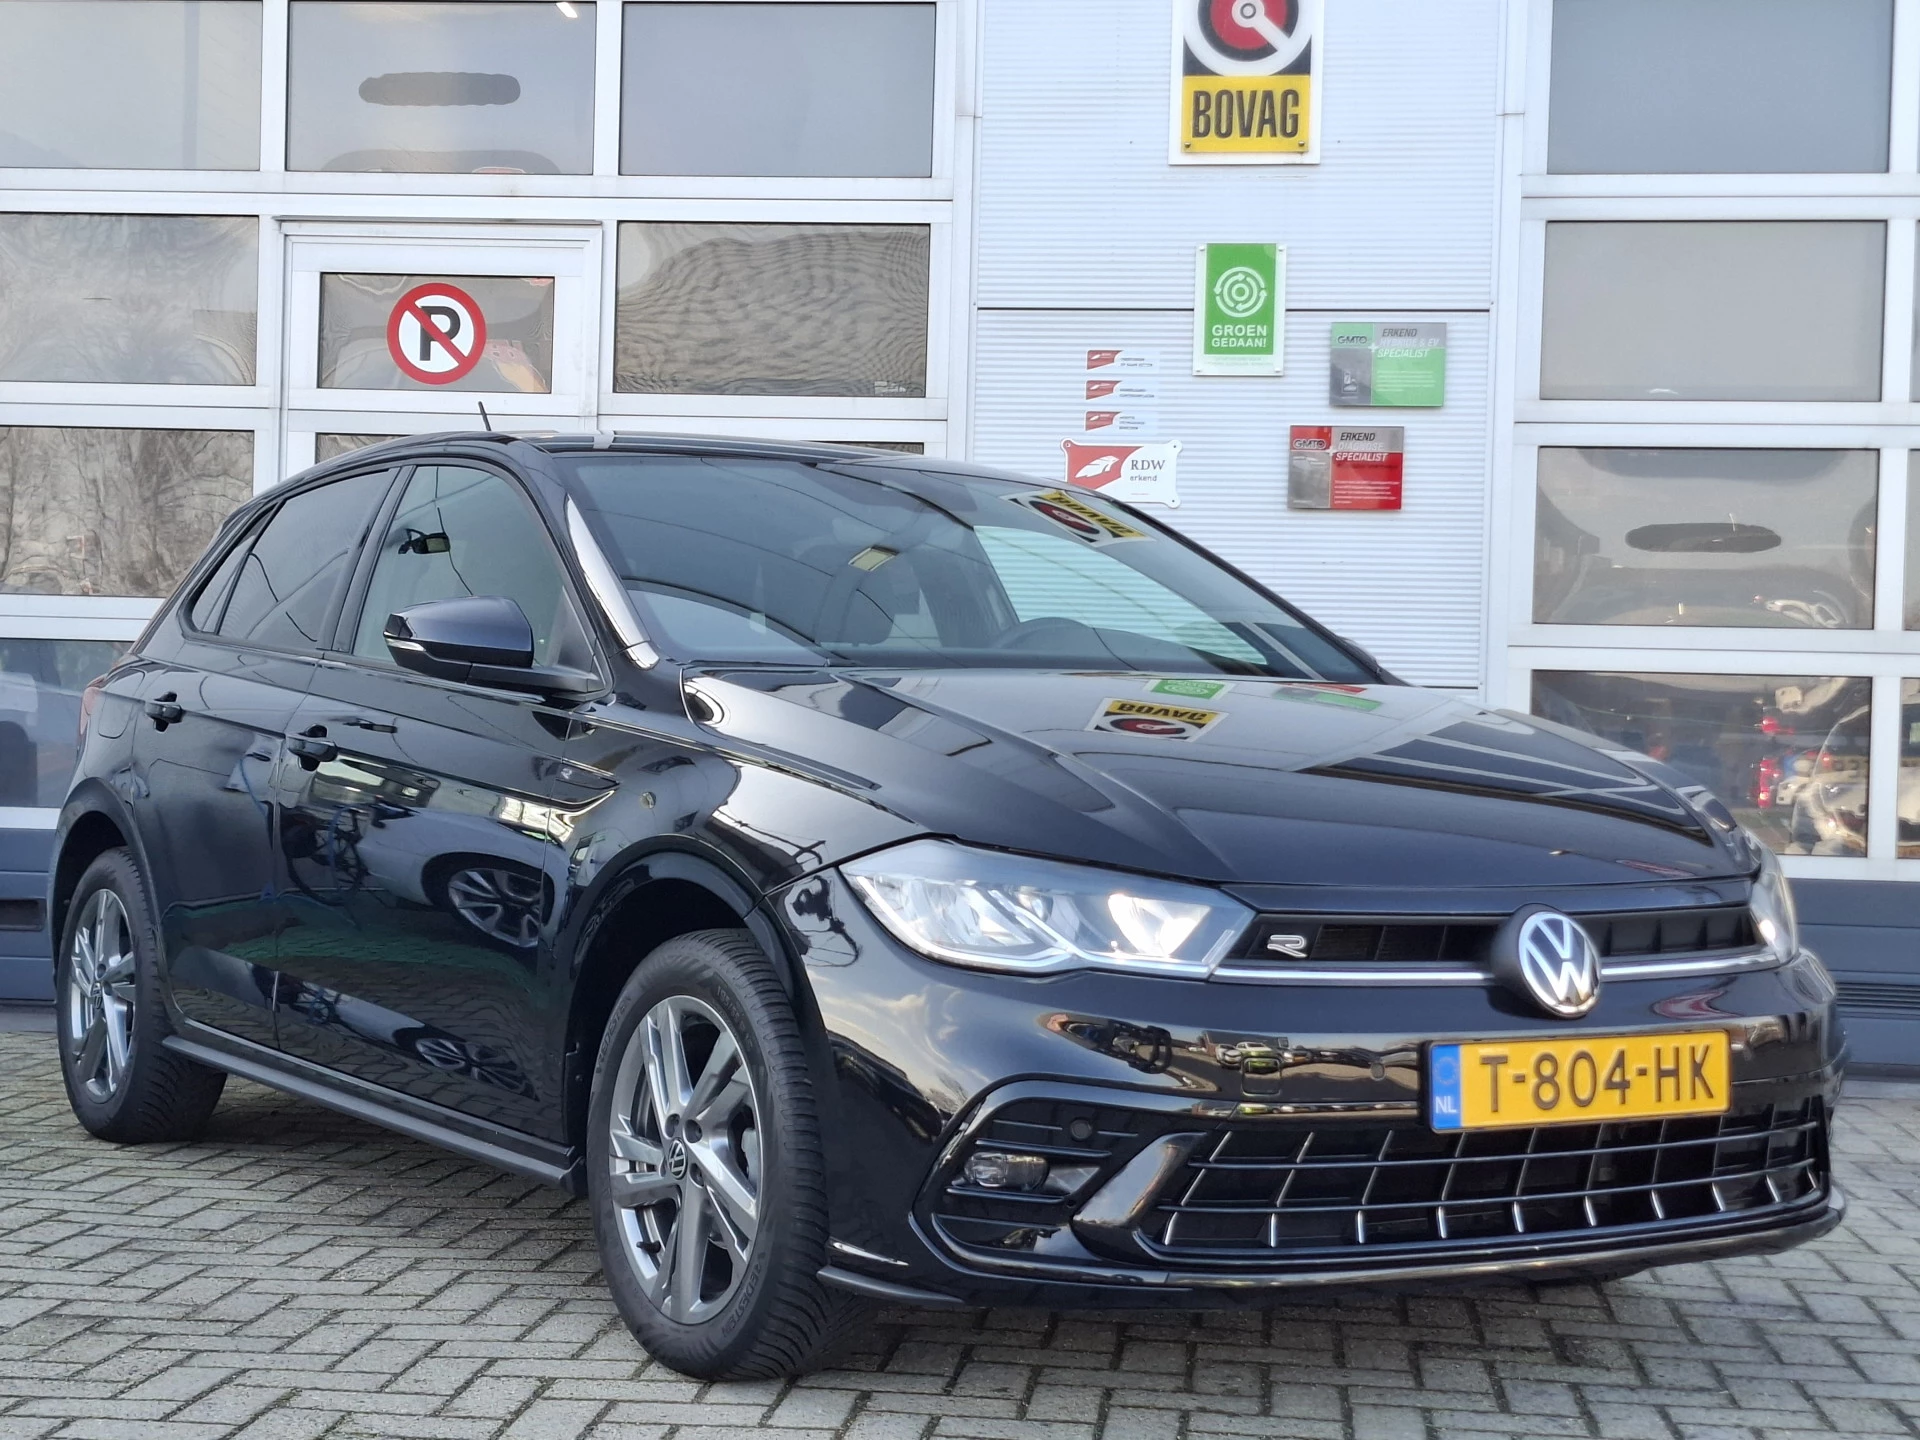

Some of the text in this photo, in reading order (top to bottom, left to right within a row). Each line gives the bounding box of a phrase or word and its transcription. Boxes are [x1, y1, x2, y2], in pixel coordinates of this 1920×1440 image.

[1191, 88, 1301, 139] BOVAG
[420, 305, 461, 361] P
[1211, 324, 1268, 337] GROEN
[1381, 328, 1418, 338] ERKEND
[1211, 337, 1267, 348] GEDAAN!
[1427, 338, 1441, 348] EV
[1377, 348, 1430, 358] SPECIALIST
[1340, 432, 1376, 441] ERKEND
[1335, 452, 1388, 462] SPECIALIST
[1131, 459, 1166, 471] RDW
[1479, 1043, 1714, 1114] T-804-HK
[1435, 1096, 1457, 1114] NL
